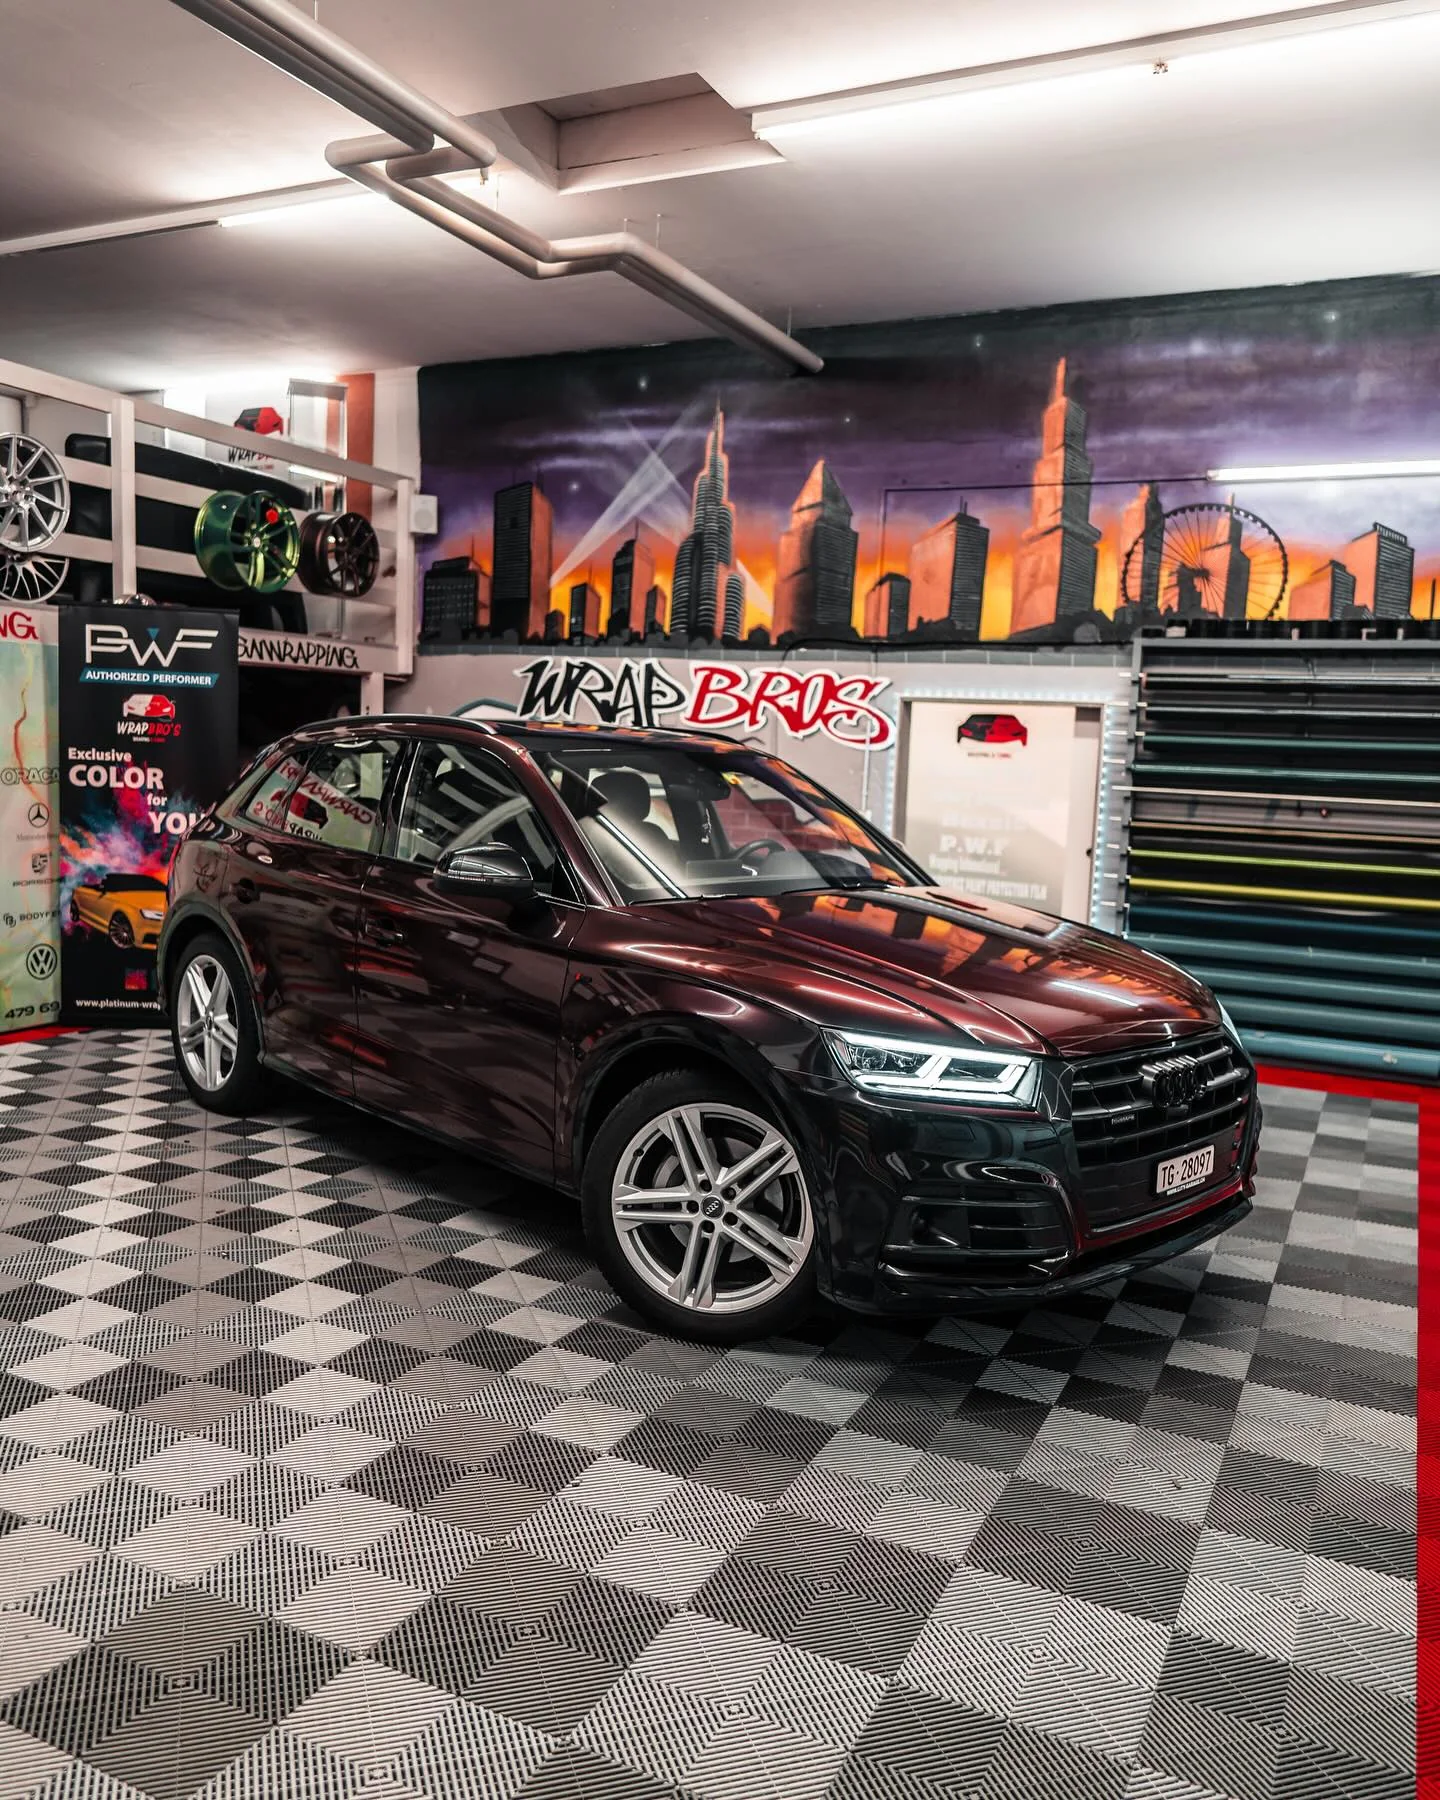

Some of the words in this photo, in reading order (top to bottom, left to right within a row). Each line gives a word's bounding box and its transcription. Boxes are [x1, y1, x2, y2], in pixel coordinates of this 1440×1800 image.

[86, 624, 218, 667] PWF
[86, 671, 150, 683] AUTHORIZED
[152, 673, 212, 686] PERFORMER
[516, 658, 686, 728] WRAP
[685, 663, 893, 747] BROS
[68, 748, 132, 762] Exclusive
[69, 764, 164, 790] COLOR
[147, 793, 167, 806] for
[5, 1003, 35, 1019] 479
